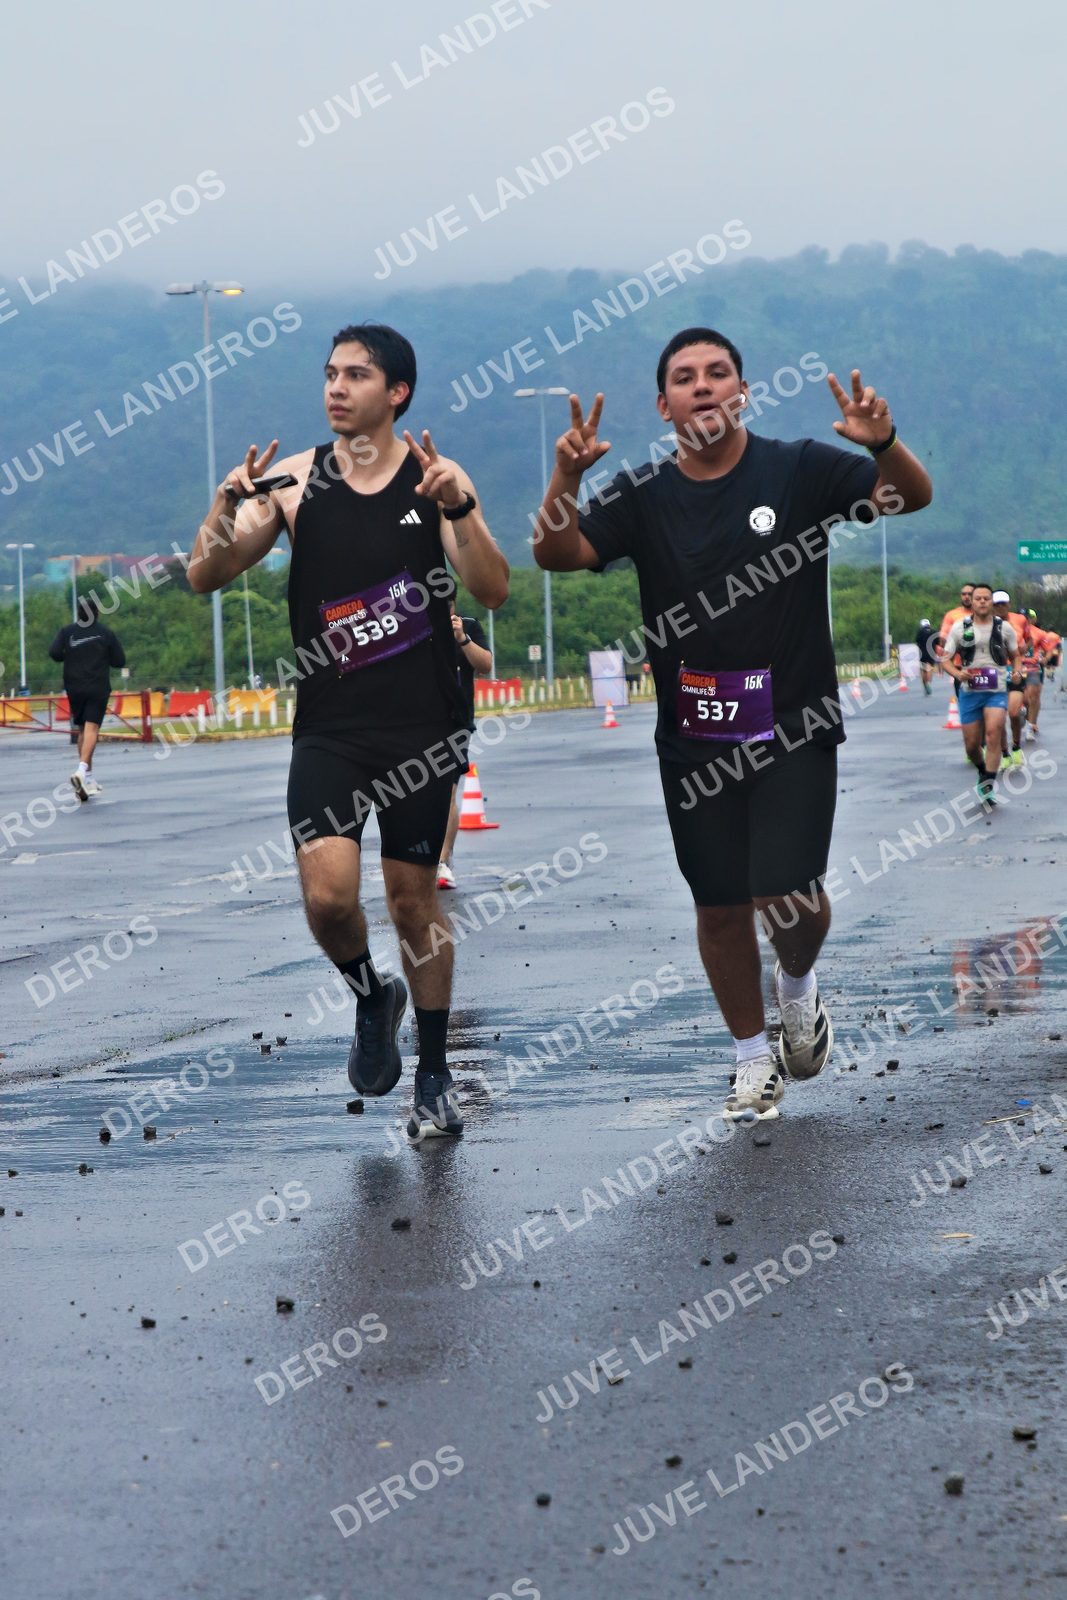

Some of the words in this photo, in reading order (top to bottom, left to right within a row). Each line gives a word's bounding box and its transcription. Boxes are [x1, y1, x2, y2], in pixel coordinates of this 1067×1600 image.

[388, 580, 407, 600] 15K
[325, 600, 364, 621] CARRERA
[328, 613, 358, 629] OMNILIFE
[352, 614, 398, 646] 539
[682, 673, 716, 688] CARRERA
[744, 674, 764, 690] 15K
[682, 684, 708, 696] OMNILIFE
[697, 700, 738, 721] 537
